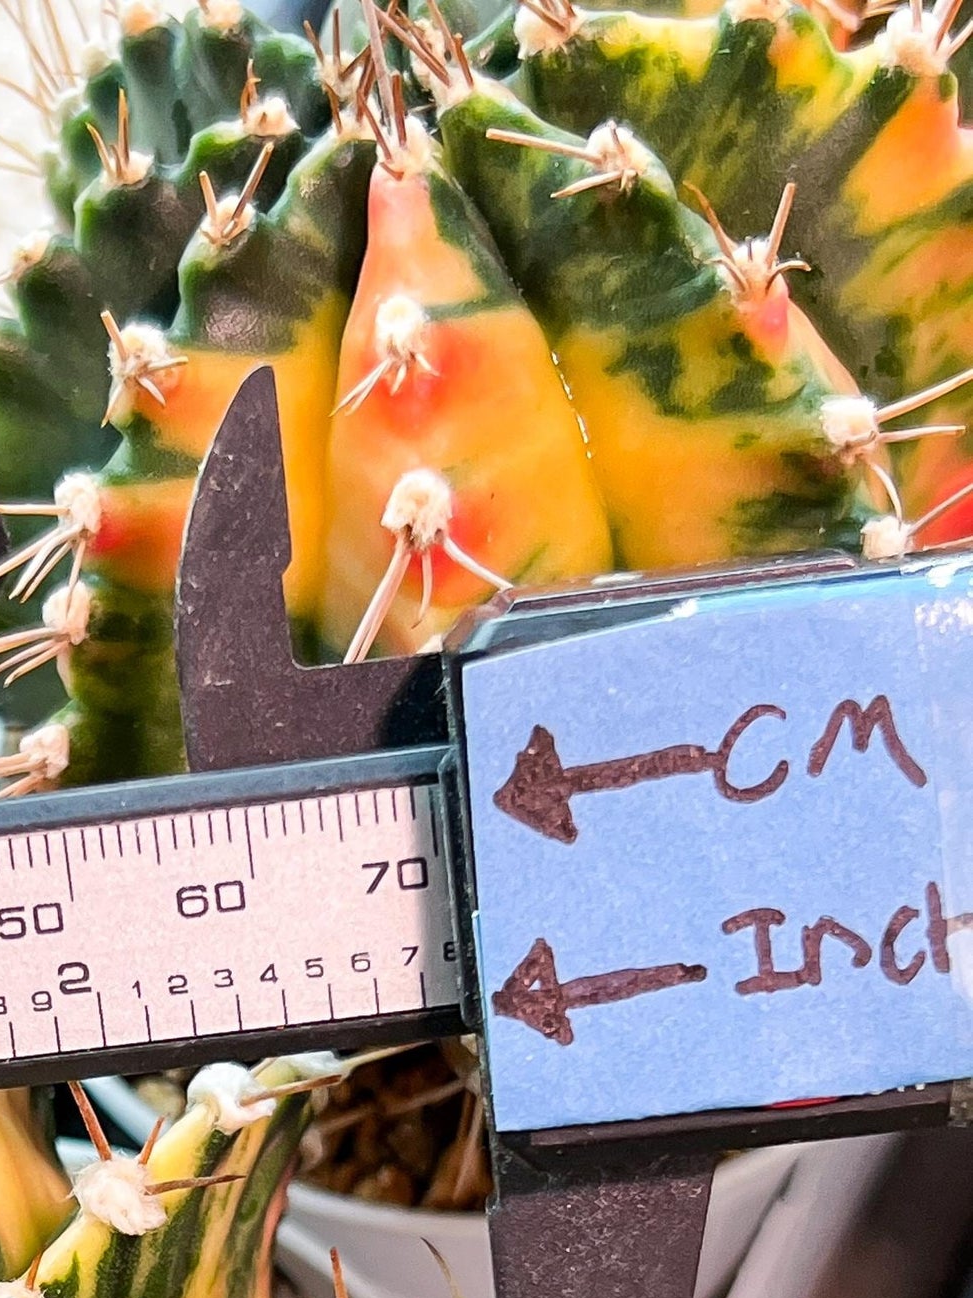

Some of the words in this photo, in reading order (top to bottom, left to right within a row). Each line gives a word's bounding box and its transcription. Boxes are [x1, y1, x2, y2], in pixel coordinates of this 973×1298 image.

[175, 880, 246, 919] 60
[361, 856, 429, 895] 70
[31, 990, 53, 1012] 9
[57, 961, 92, 995] 2
[131, 980, 142, 999] 1
[167, 974, 189, 996] 2
[213, 968, 234, 988] 3
[259, 963, 279, 983] 4
[304, 957, 324, 979] 5
[350, 951, 371, 973] 6
[401, 945, 420, 967] 7
